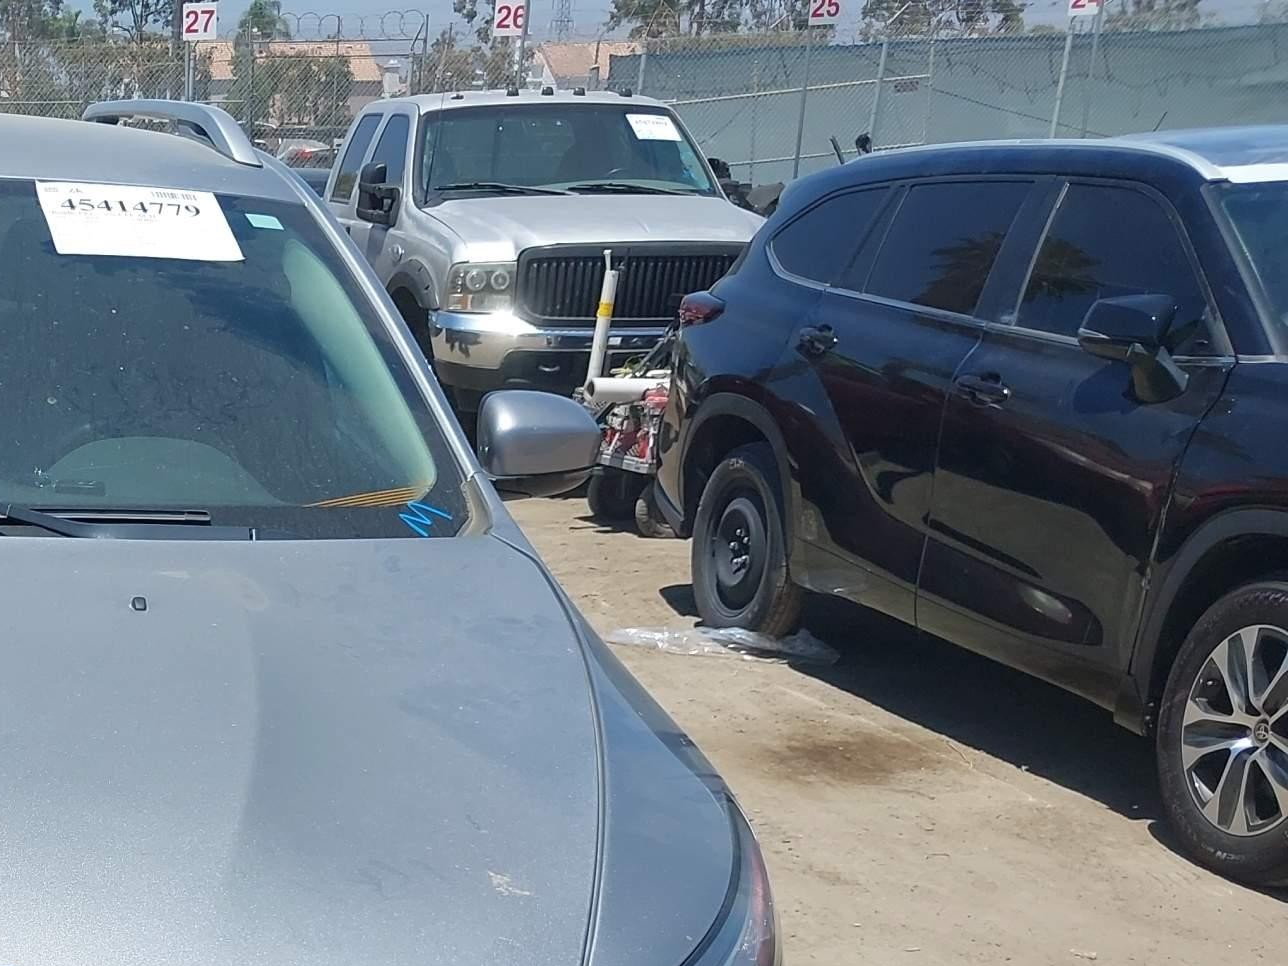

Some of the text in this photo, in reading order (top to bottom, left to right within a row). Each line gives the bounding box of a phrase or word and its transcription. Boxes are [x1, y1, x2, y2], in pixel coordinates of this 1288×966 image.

[495, 5, 525, 29] 26
[811, 0, 841, 18] 25
[185, 9, 216, 34] 27
[60, 198, 202, 218] 45414779
